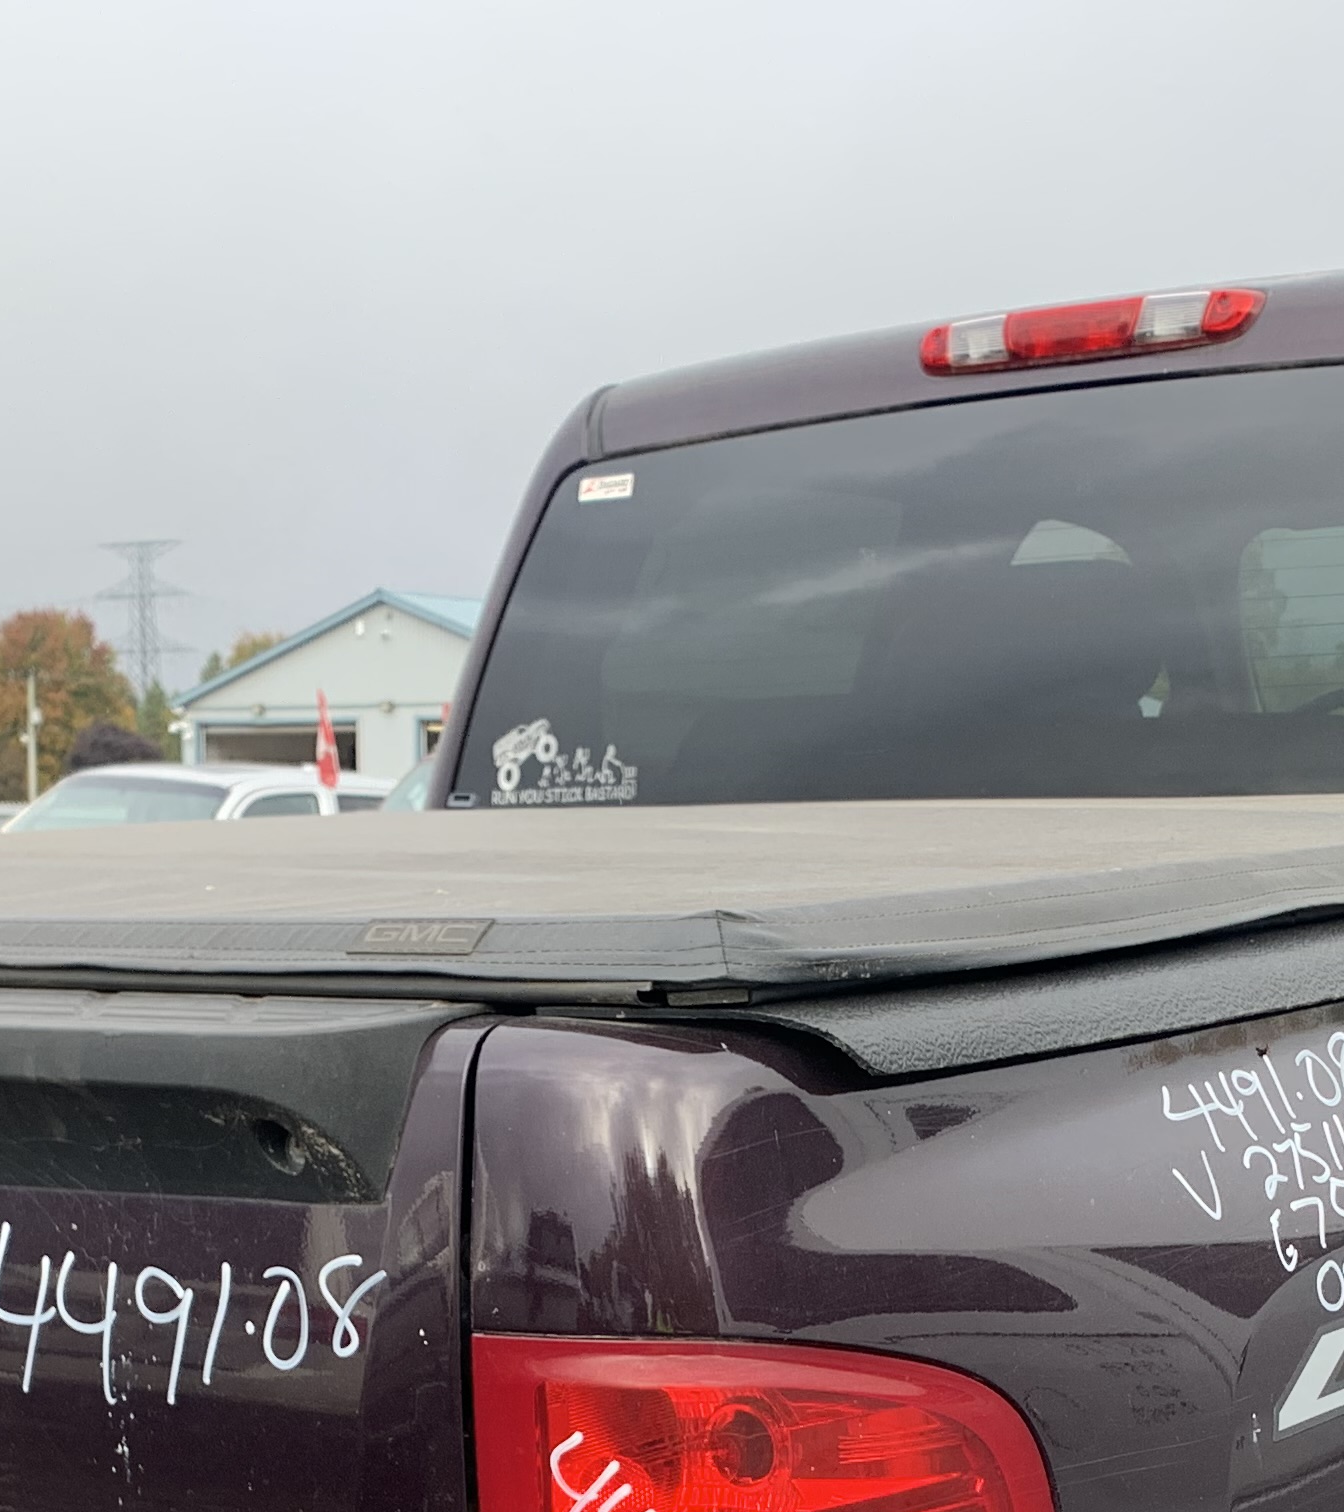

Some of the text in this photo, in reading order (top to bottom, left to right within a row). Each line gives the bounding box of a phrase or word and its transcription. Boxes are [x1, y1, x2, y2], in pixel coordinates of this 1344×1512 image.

[491, 790, 518, 805] RUN
[519, 788, 544, 804] YOU
[364, 923, 476, 943] GMC
